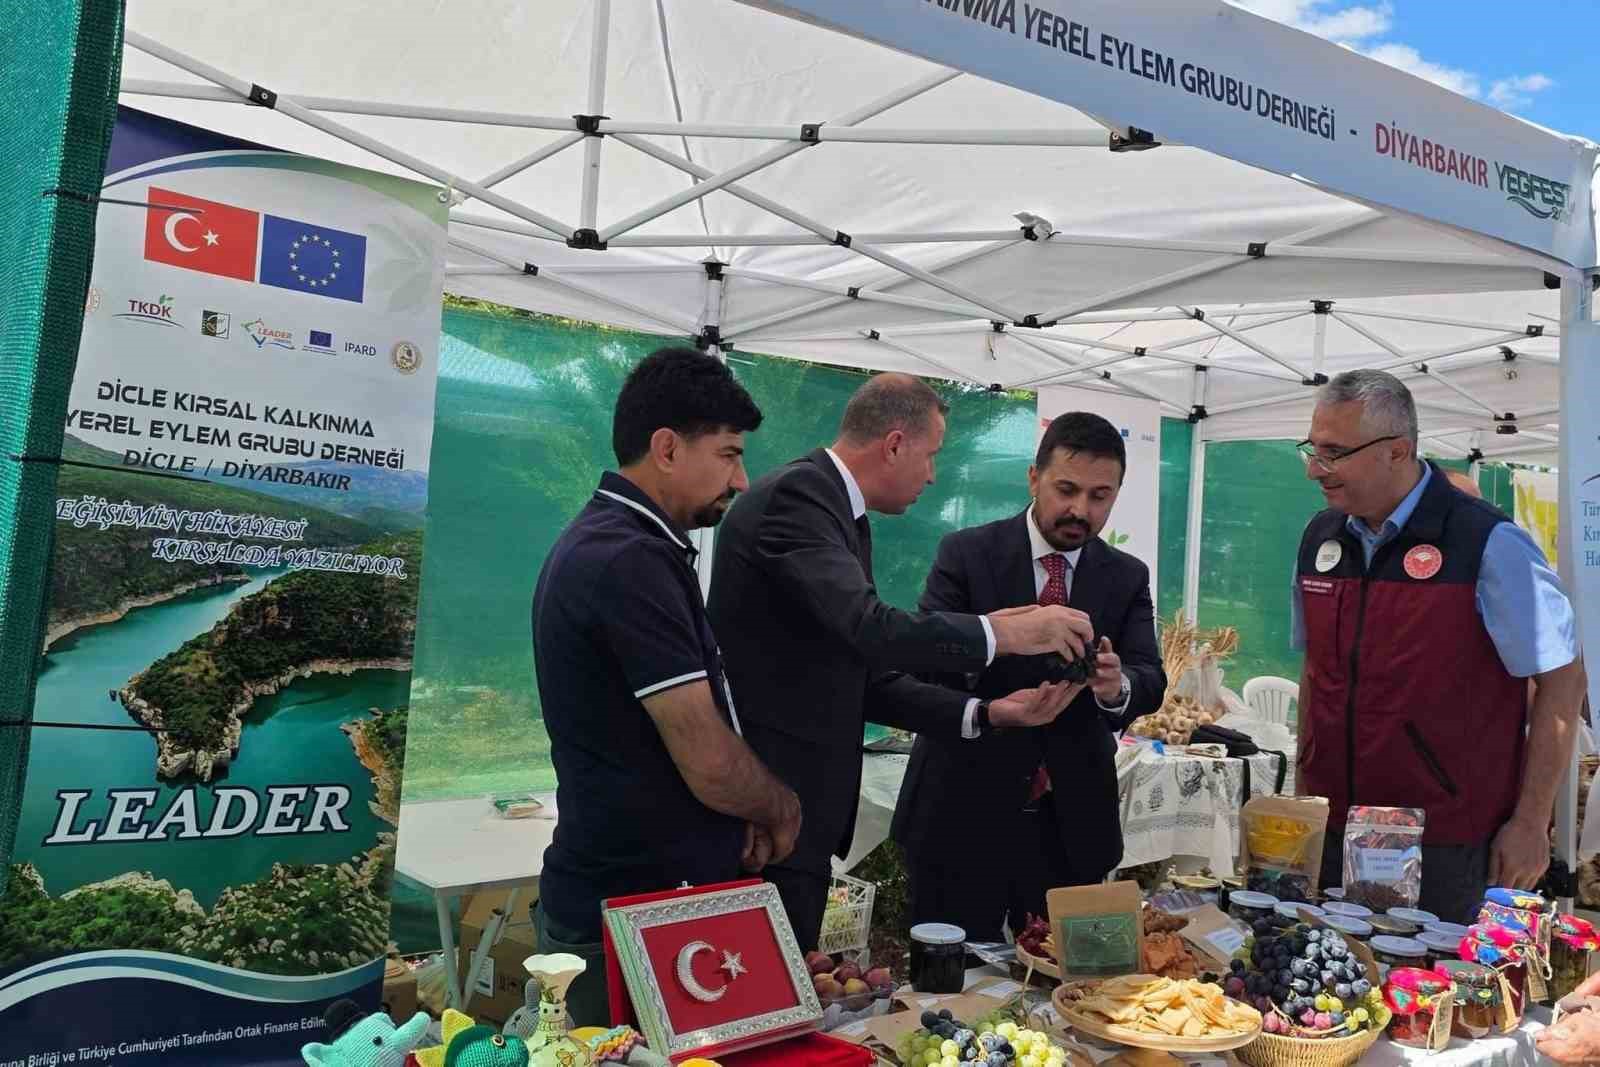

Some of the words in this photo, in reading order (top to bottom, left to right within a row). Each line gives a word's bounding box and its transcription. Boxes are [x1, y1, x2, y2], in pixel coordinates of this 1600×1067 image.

[1024, 3, 1096, 61] YEREL
[1100, 32, 1176, 87] EYLEM
[1179, 63, 1252, 112] GRUBU
[1256, 88, 1336, 141] DERNEĞİ
[1375, 120, 1489, 189] DİYARBAKIR
[128, 299, 172, 318] TKDK
[344, 342, 377, 357] IPARD
[97, 378, 169, 408] DİCLE
[173, 392, 257, 421] KIRSAL
[264, 405, 375, 437] KALKINMA
[65, 409, 142, 436] YEREL
[150, 419, 231, 448] EYLEM
[238, 432, 315, 458] GRUBU
[320, 443, 405, 470] DERNEĞİ
[122, 447, 197, 473] DİCLE
[221, 459, 352, 491] DİYARBAKIR
[152, 538, 282, 567] KIRSALDA
[284, 547, 408, 580] YAZILIYOR
[43, 785, 351, 846] LEADER
[62, 1052, 76, 1062] ve
[78, 1046, 116, 1061] Türkiye
[118, 1035, 181, 1056] Cumhuriyeti
[182, 1029, 232, 1046] Tarafından
[234, 1023, 262, 1039] Ortak
[263, 1021, 299, 1035] Finanse
